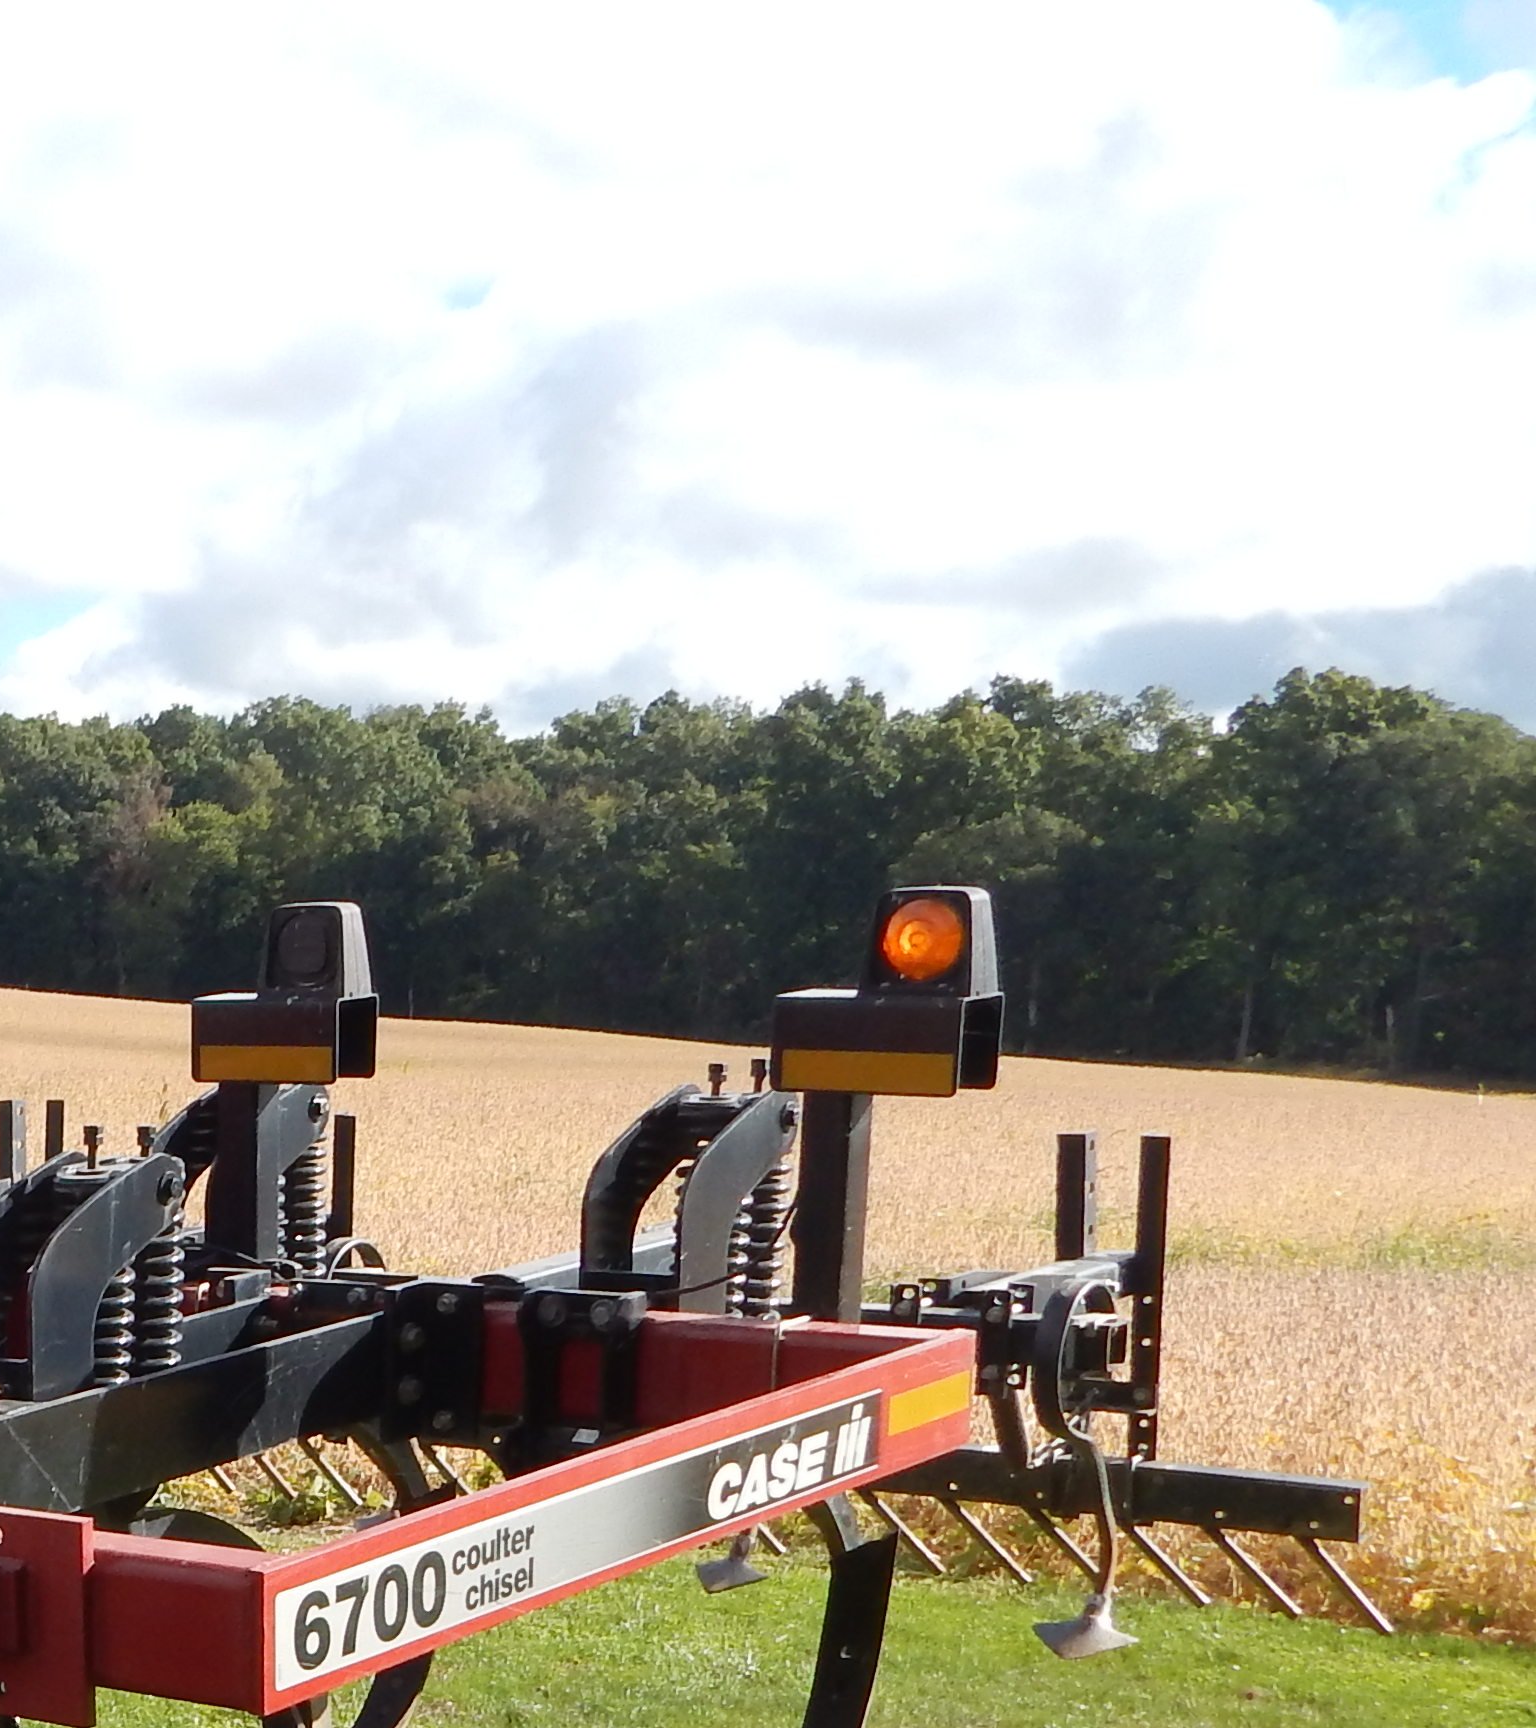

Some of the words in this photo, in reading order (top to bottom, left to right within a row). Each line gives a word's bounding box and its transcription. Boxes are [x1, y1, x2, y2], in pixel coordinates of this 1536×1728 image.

[707, 1430, 830, 1521] CASE
[452, 1525, 535, 1576] coulter
[466, 1557, 534, 1611] chisel
[293, 1550, 447, 1671] 6700
